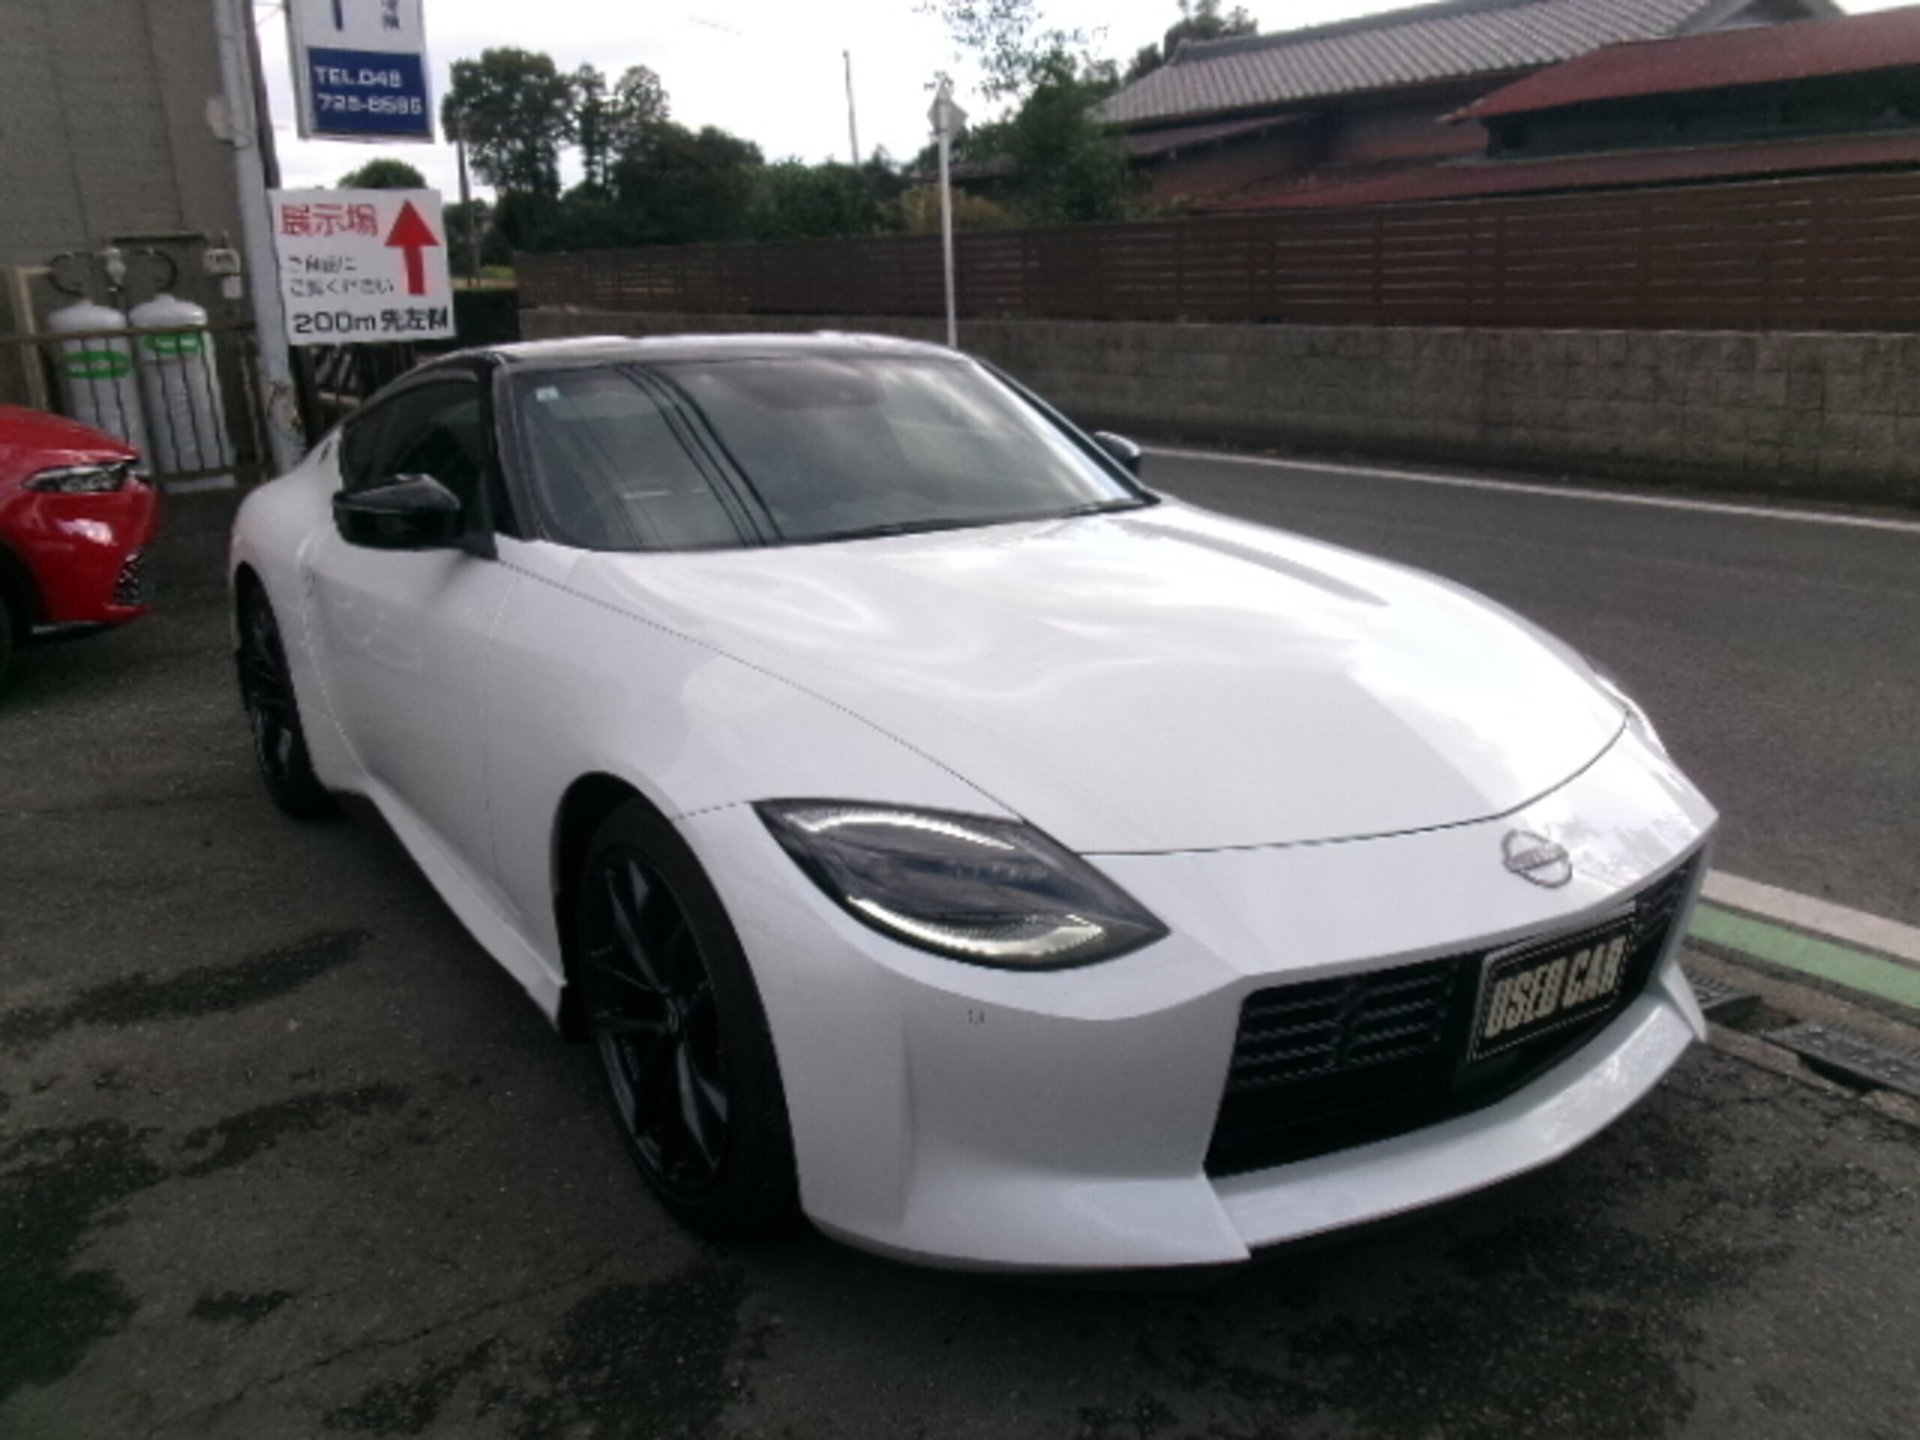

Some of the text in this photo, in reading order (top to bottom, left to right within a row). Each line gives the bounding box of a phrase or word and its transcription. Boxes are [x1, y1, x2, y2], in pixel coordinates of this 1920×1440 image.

[281, 203, 379, 236] 展示場
[1484, 936, 1626, 1038] USED CAR
